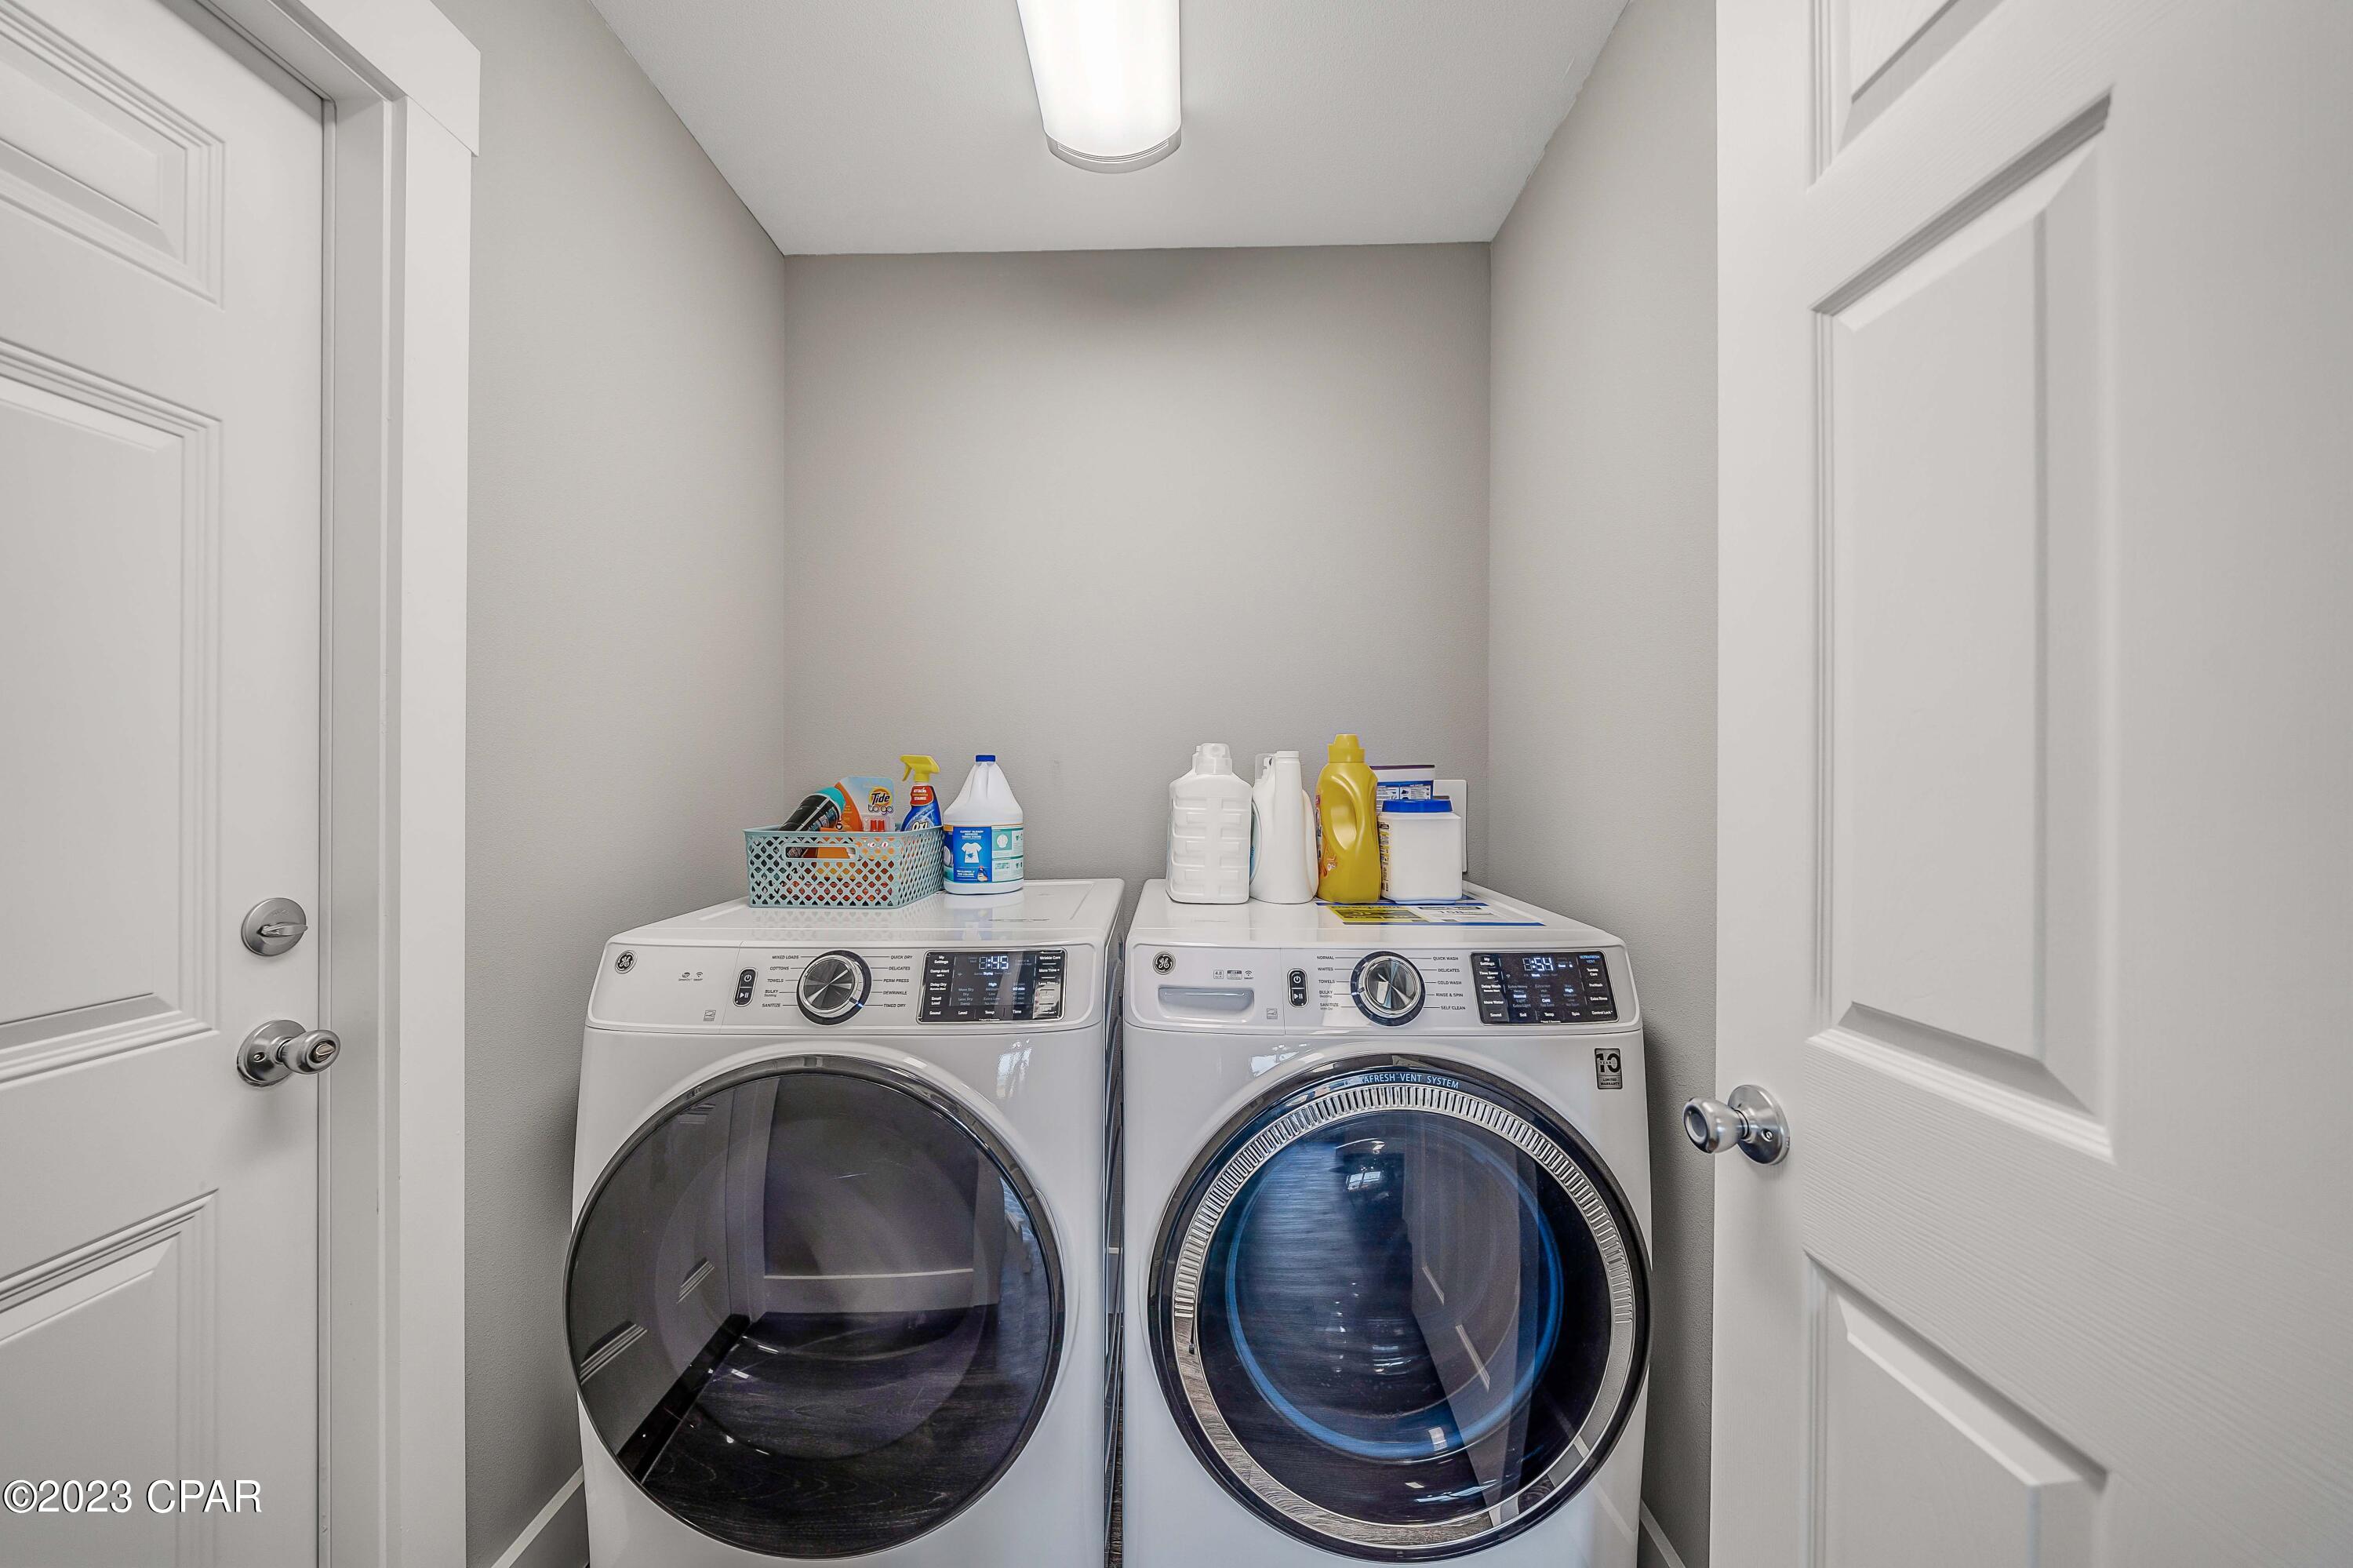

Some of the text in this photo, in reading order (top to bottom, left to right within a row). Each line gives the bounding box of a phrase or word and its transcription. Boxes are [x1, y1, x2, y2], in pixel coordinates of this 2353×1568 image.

[871, 791, 890, 805] Tide
[880, 806, 893, 815] go
[1596, 1053, 1620, 1072] 10
[1399, 1073, 1422, 1082] VENT
[1427, 1075, 1459, 1089] SYSTEM
